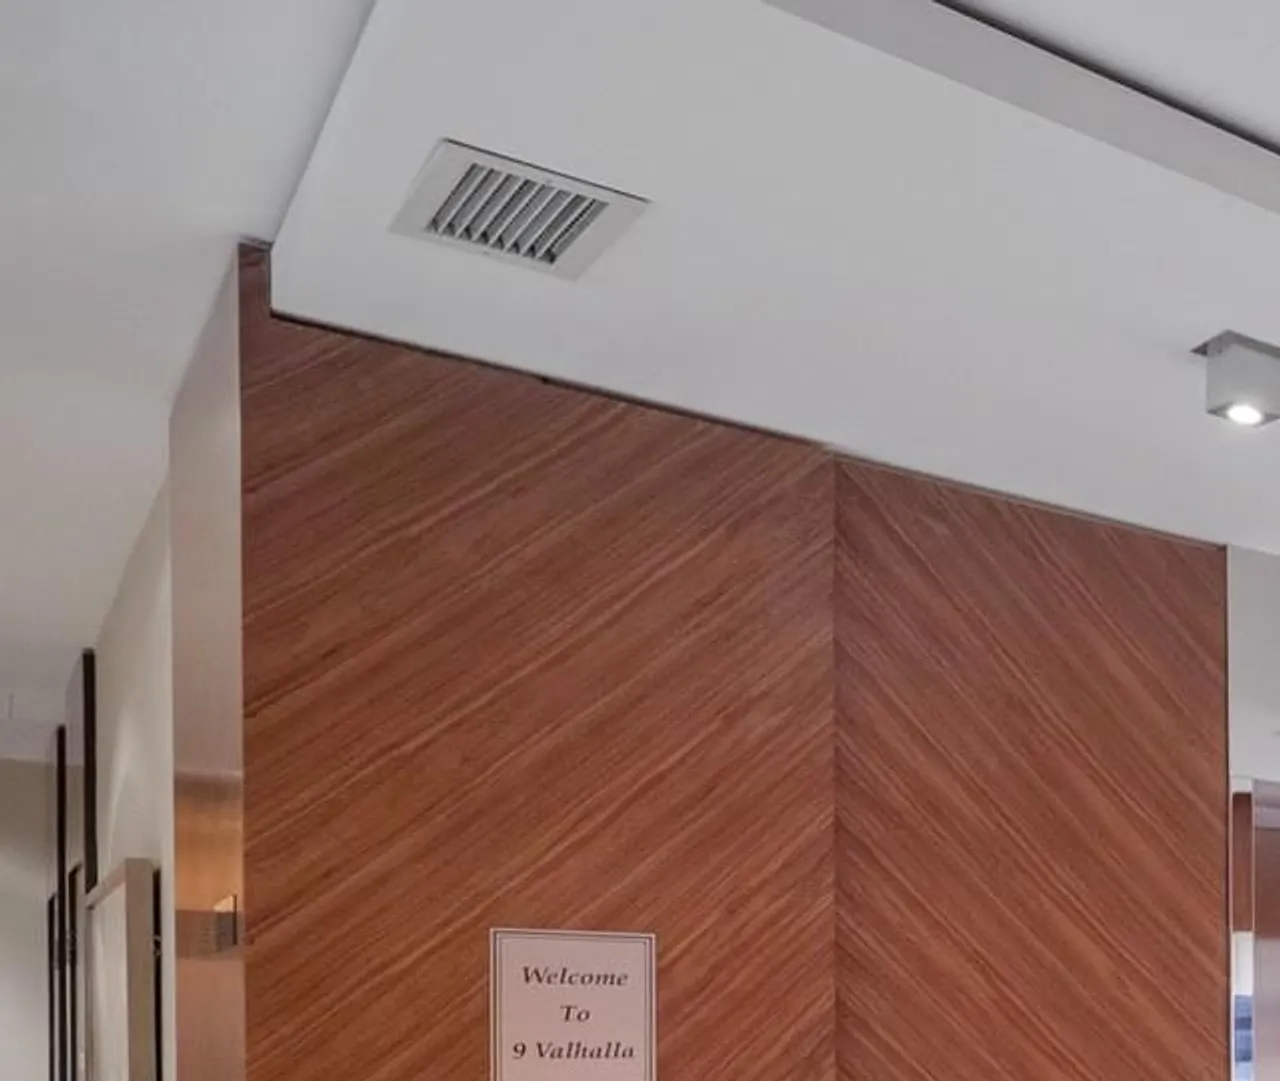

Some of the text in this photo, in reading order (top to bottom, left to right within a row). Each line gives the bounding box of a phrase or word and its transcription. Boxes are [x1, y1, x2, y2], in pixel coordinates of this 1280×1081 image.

[522, 966, 629, 986] Welcome
[560, 1005, 591, 1023] To
[512, 1042, 635, 1060] 9 Valhalla
